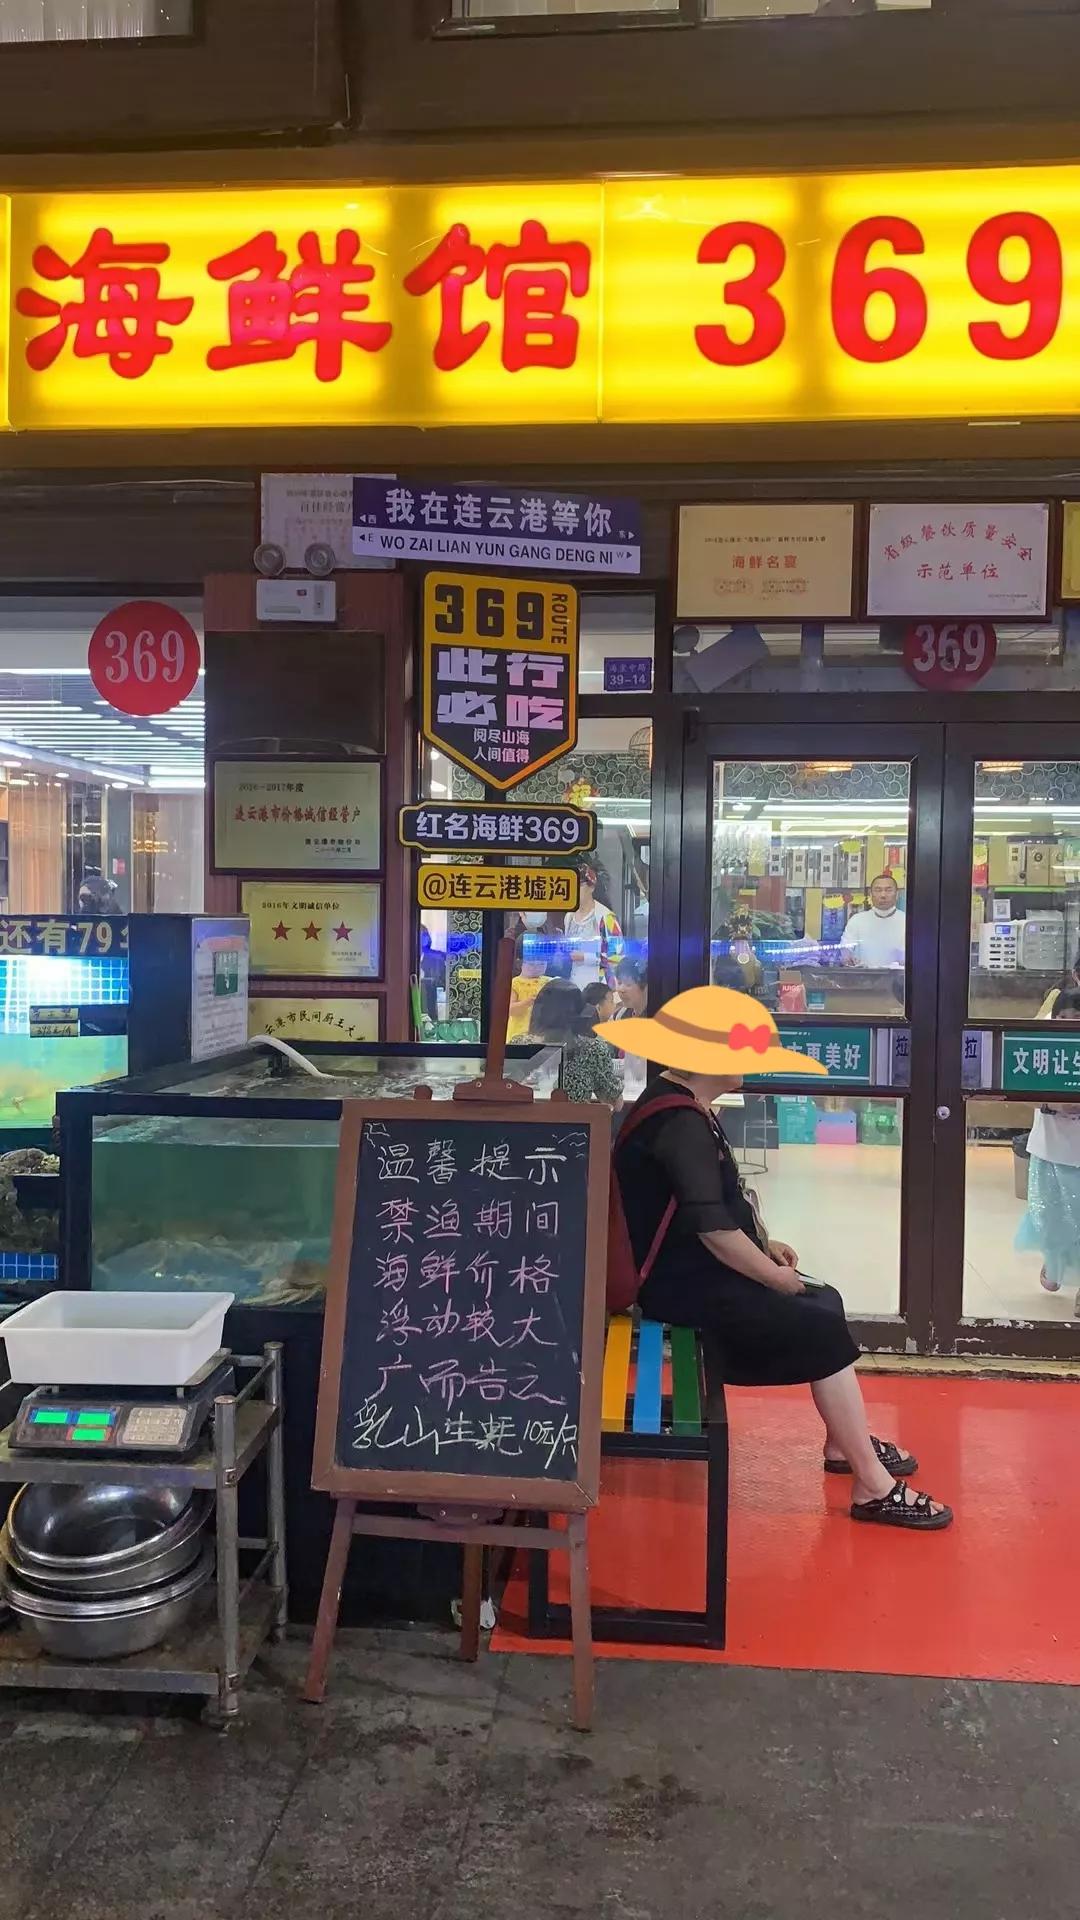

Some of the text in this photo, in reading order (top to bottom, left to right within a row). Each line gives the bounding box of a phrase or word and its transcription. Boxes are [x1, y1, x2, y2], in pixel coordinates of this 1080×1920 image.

[16, 211, 1064, 383] 海鲜馆 369
[385, 488, 612, 537] 我在连云港等你
[380, 535, 613, 565] WO ZAI LIAN YUN GANG DENG NI
[916, 560, 999, 581] 示范单位
[434, 583, 546, 640] 369
[551, 592, 569, 645] ROUTE
[104, 630, 186, 684] 369
[914, 623, 987, 673] 369
[436, 648, 565, 689] 此行
[609, 673, 647, 686] 39-14
[436, 690, 565, 730] 必吃
[473, 728, 531, 746] 阅尽山海
[473, 746, 531, 764] 人间值得
[234, 804, 361, 824] 连云港市价格诚信经营户
[416, 811, 580, 844] 红名海鲜369
[422, 872, 571, 902] @连云港墟沟
[264, 1010, 366, 1041] 云港市民间厨王大
[895, 1035, 909, 1057] 拉
[964, 1036, 978, 1059] 拉
[376, 1139, 567, 1184] 温馨提示
[375, 1199, 560, 1244] 禁渔期间
[373, 1250, 561, 1298] 海鲜价格
[376, 1299, 559, 1348] 浮动较大
[365, 1354, 568, 1411] 广而告之
